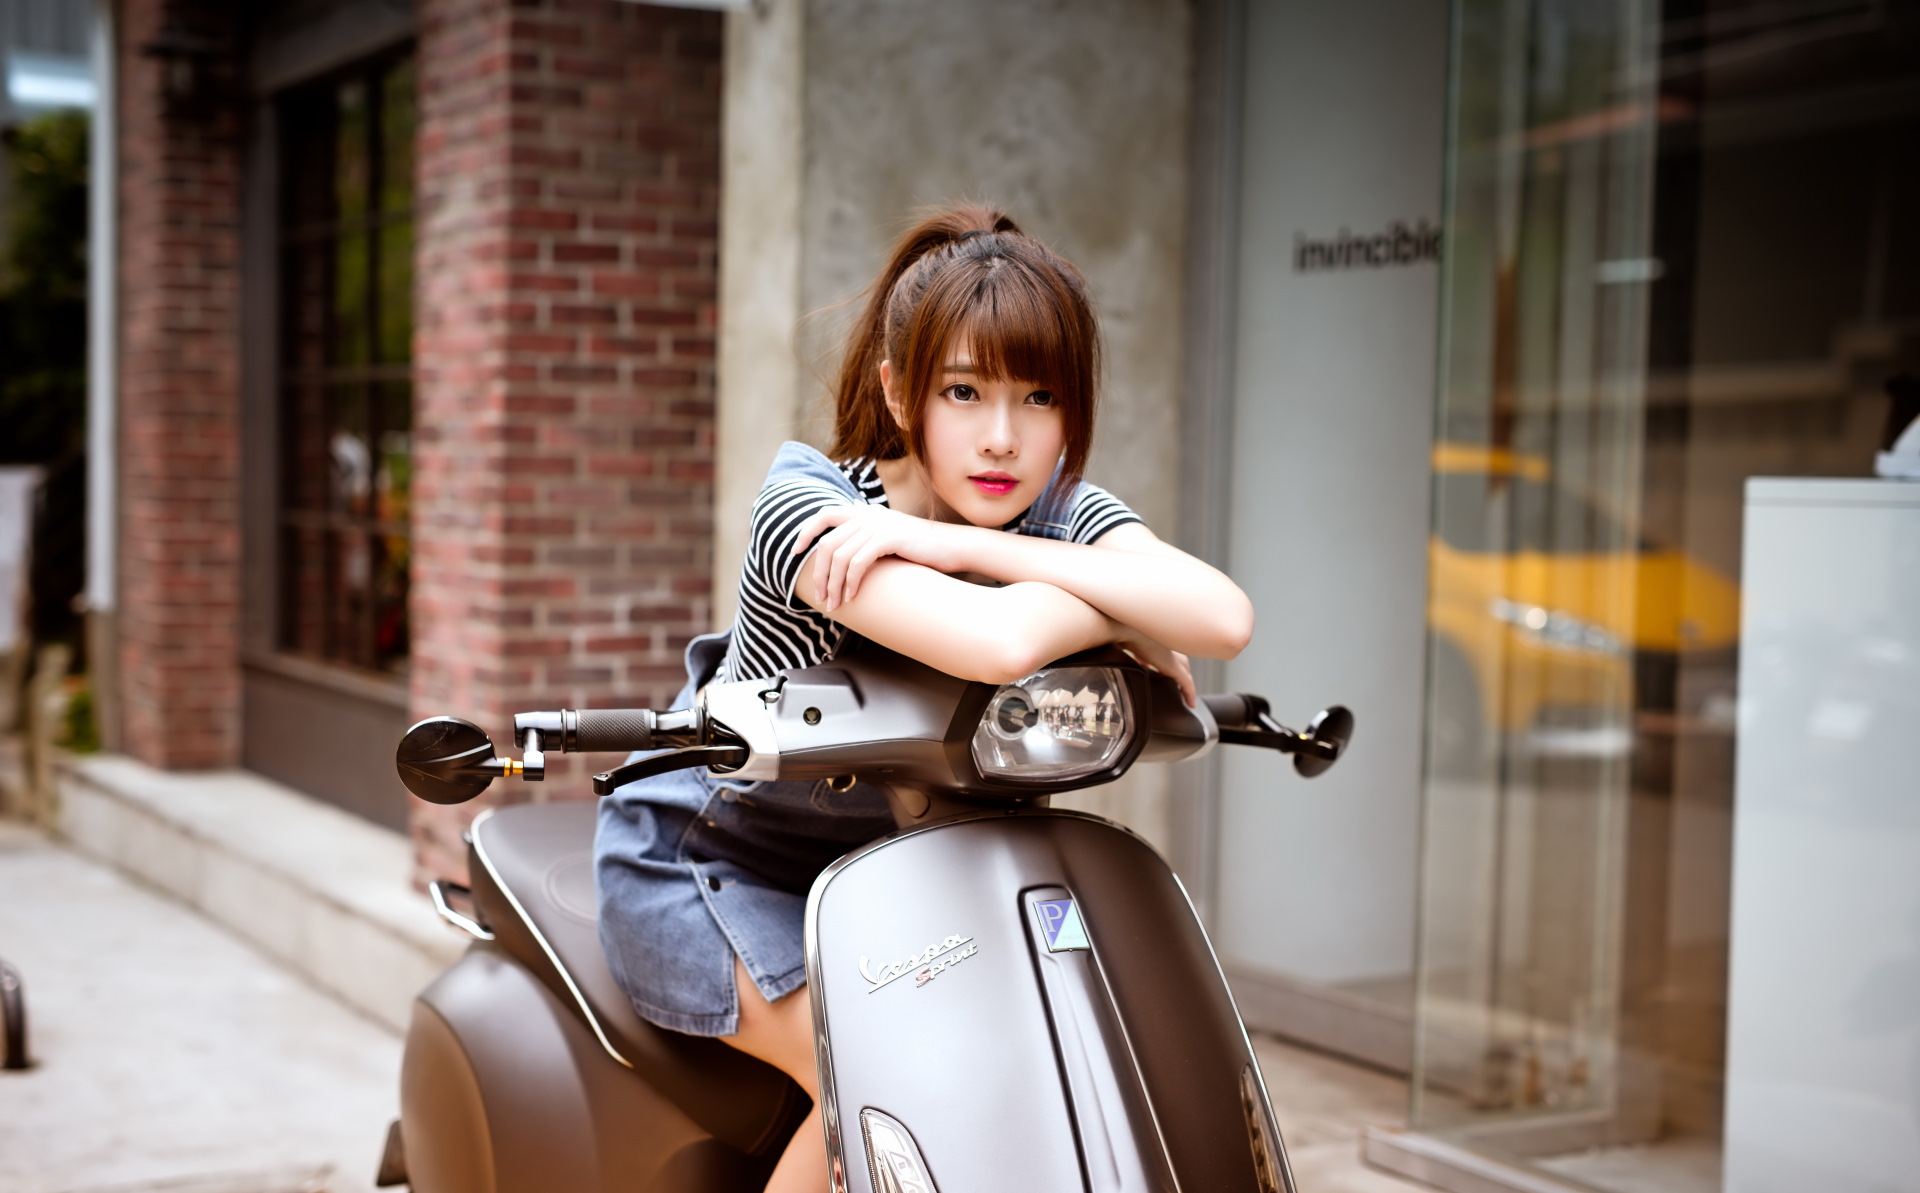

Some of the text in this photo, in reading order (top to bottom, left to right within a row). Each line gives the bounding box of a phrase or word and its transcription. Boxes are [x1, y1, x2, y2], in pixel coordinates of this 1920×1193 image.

[1040, 903, 1063, 933] P
[858, 933, 974, 994] Vespa
[916, 943, 978, 988] Sprint
